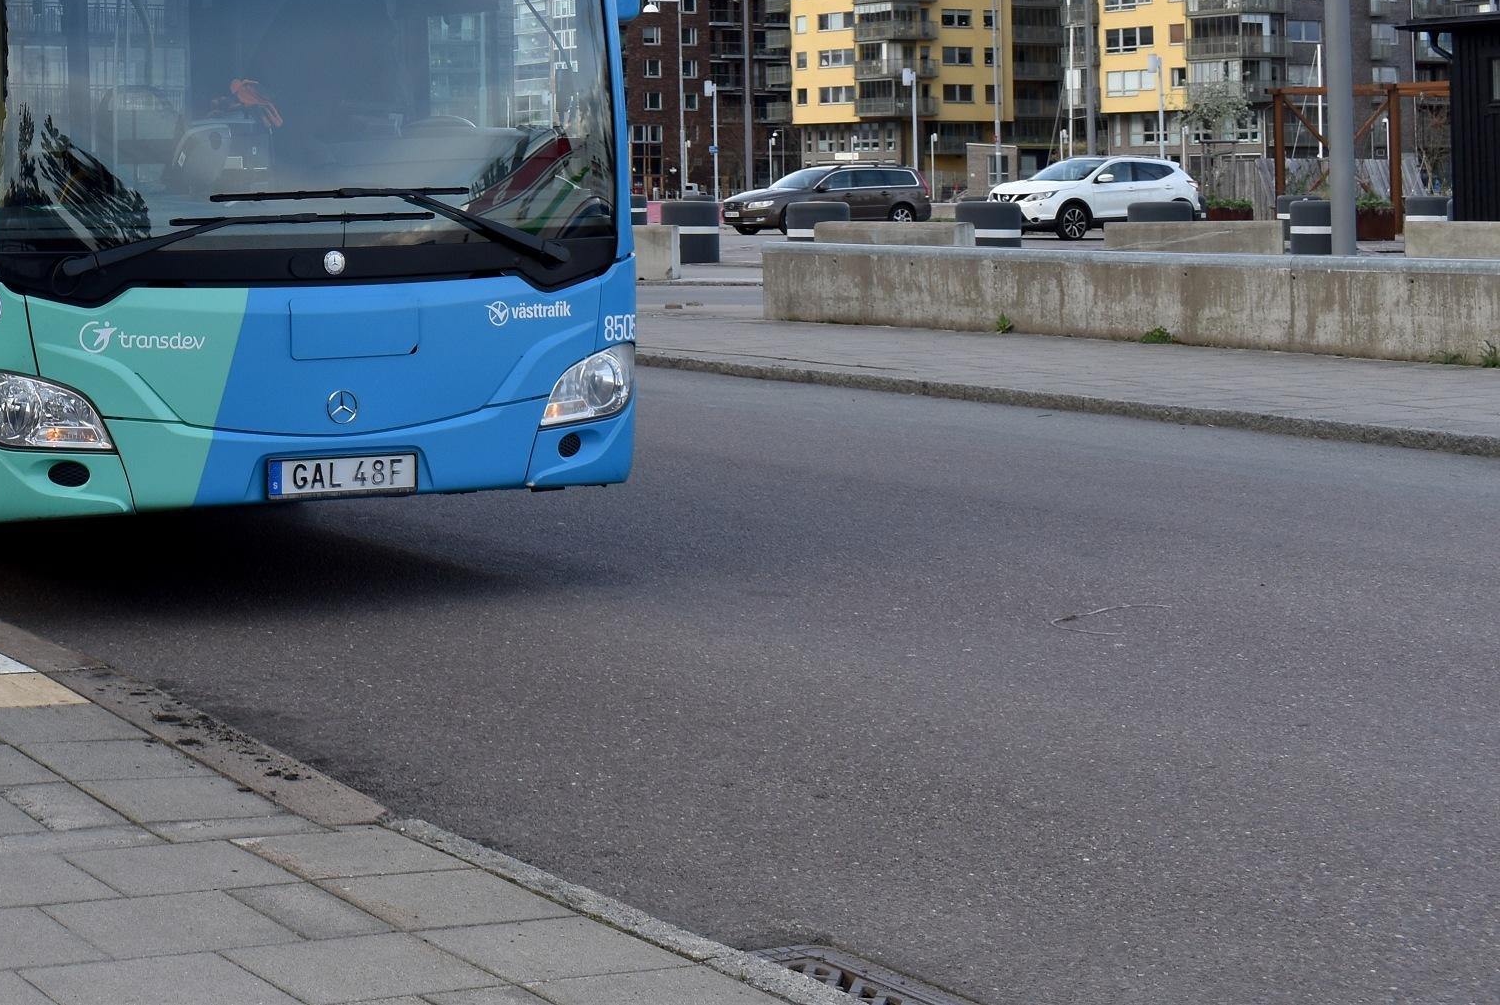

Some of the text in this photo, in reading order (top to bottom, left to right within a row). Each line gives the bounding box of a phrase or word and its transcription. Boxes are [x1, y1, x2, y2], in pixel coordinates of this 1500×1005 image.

[511, 301, 572, 319] västtrafik
[118, 331, 206, 350] transdev
[292, 462, 342, 489] GAL
[352, 459, 403, 487] 48F
